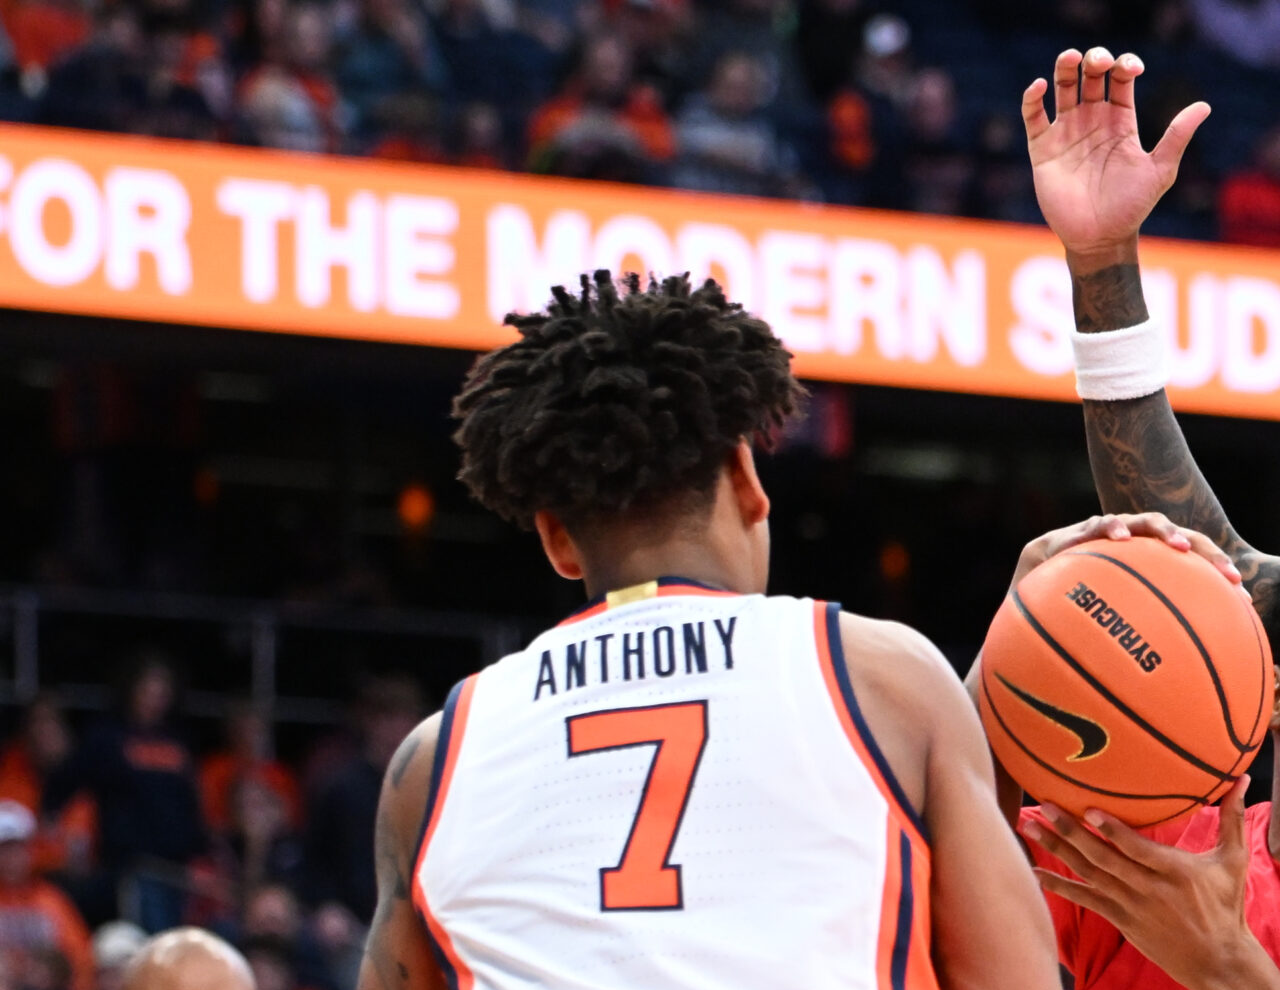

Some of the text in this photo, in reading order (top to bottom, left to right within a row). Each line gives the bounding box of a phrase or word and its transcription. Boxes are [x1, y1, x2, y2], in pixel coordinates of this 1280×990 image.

[215, 176, 461, 321] THE
[533, 616, 738, 702] ANTHONY
[1065, 582, 1162, 673] SYRACUSE
[565, 699, 709, 912] 7
